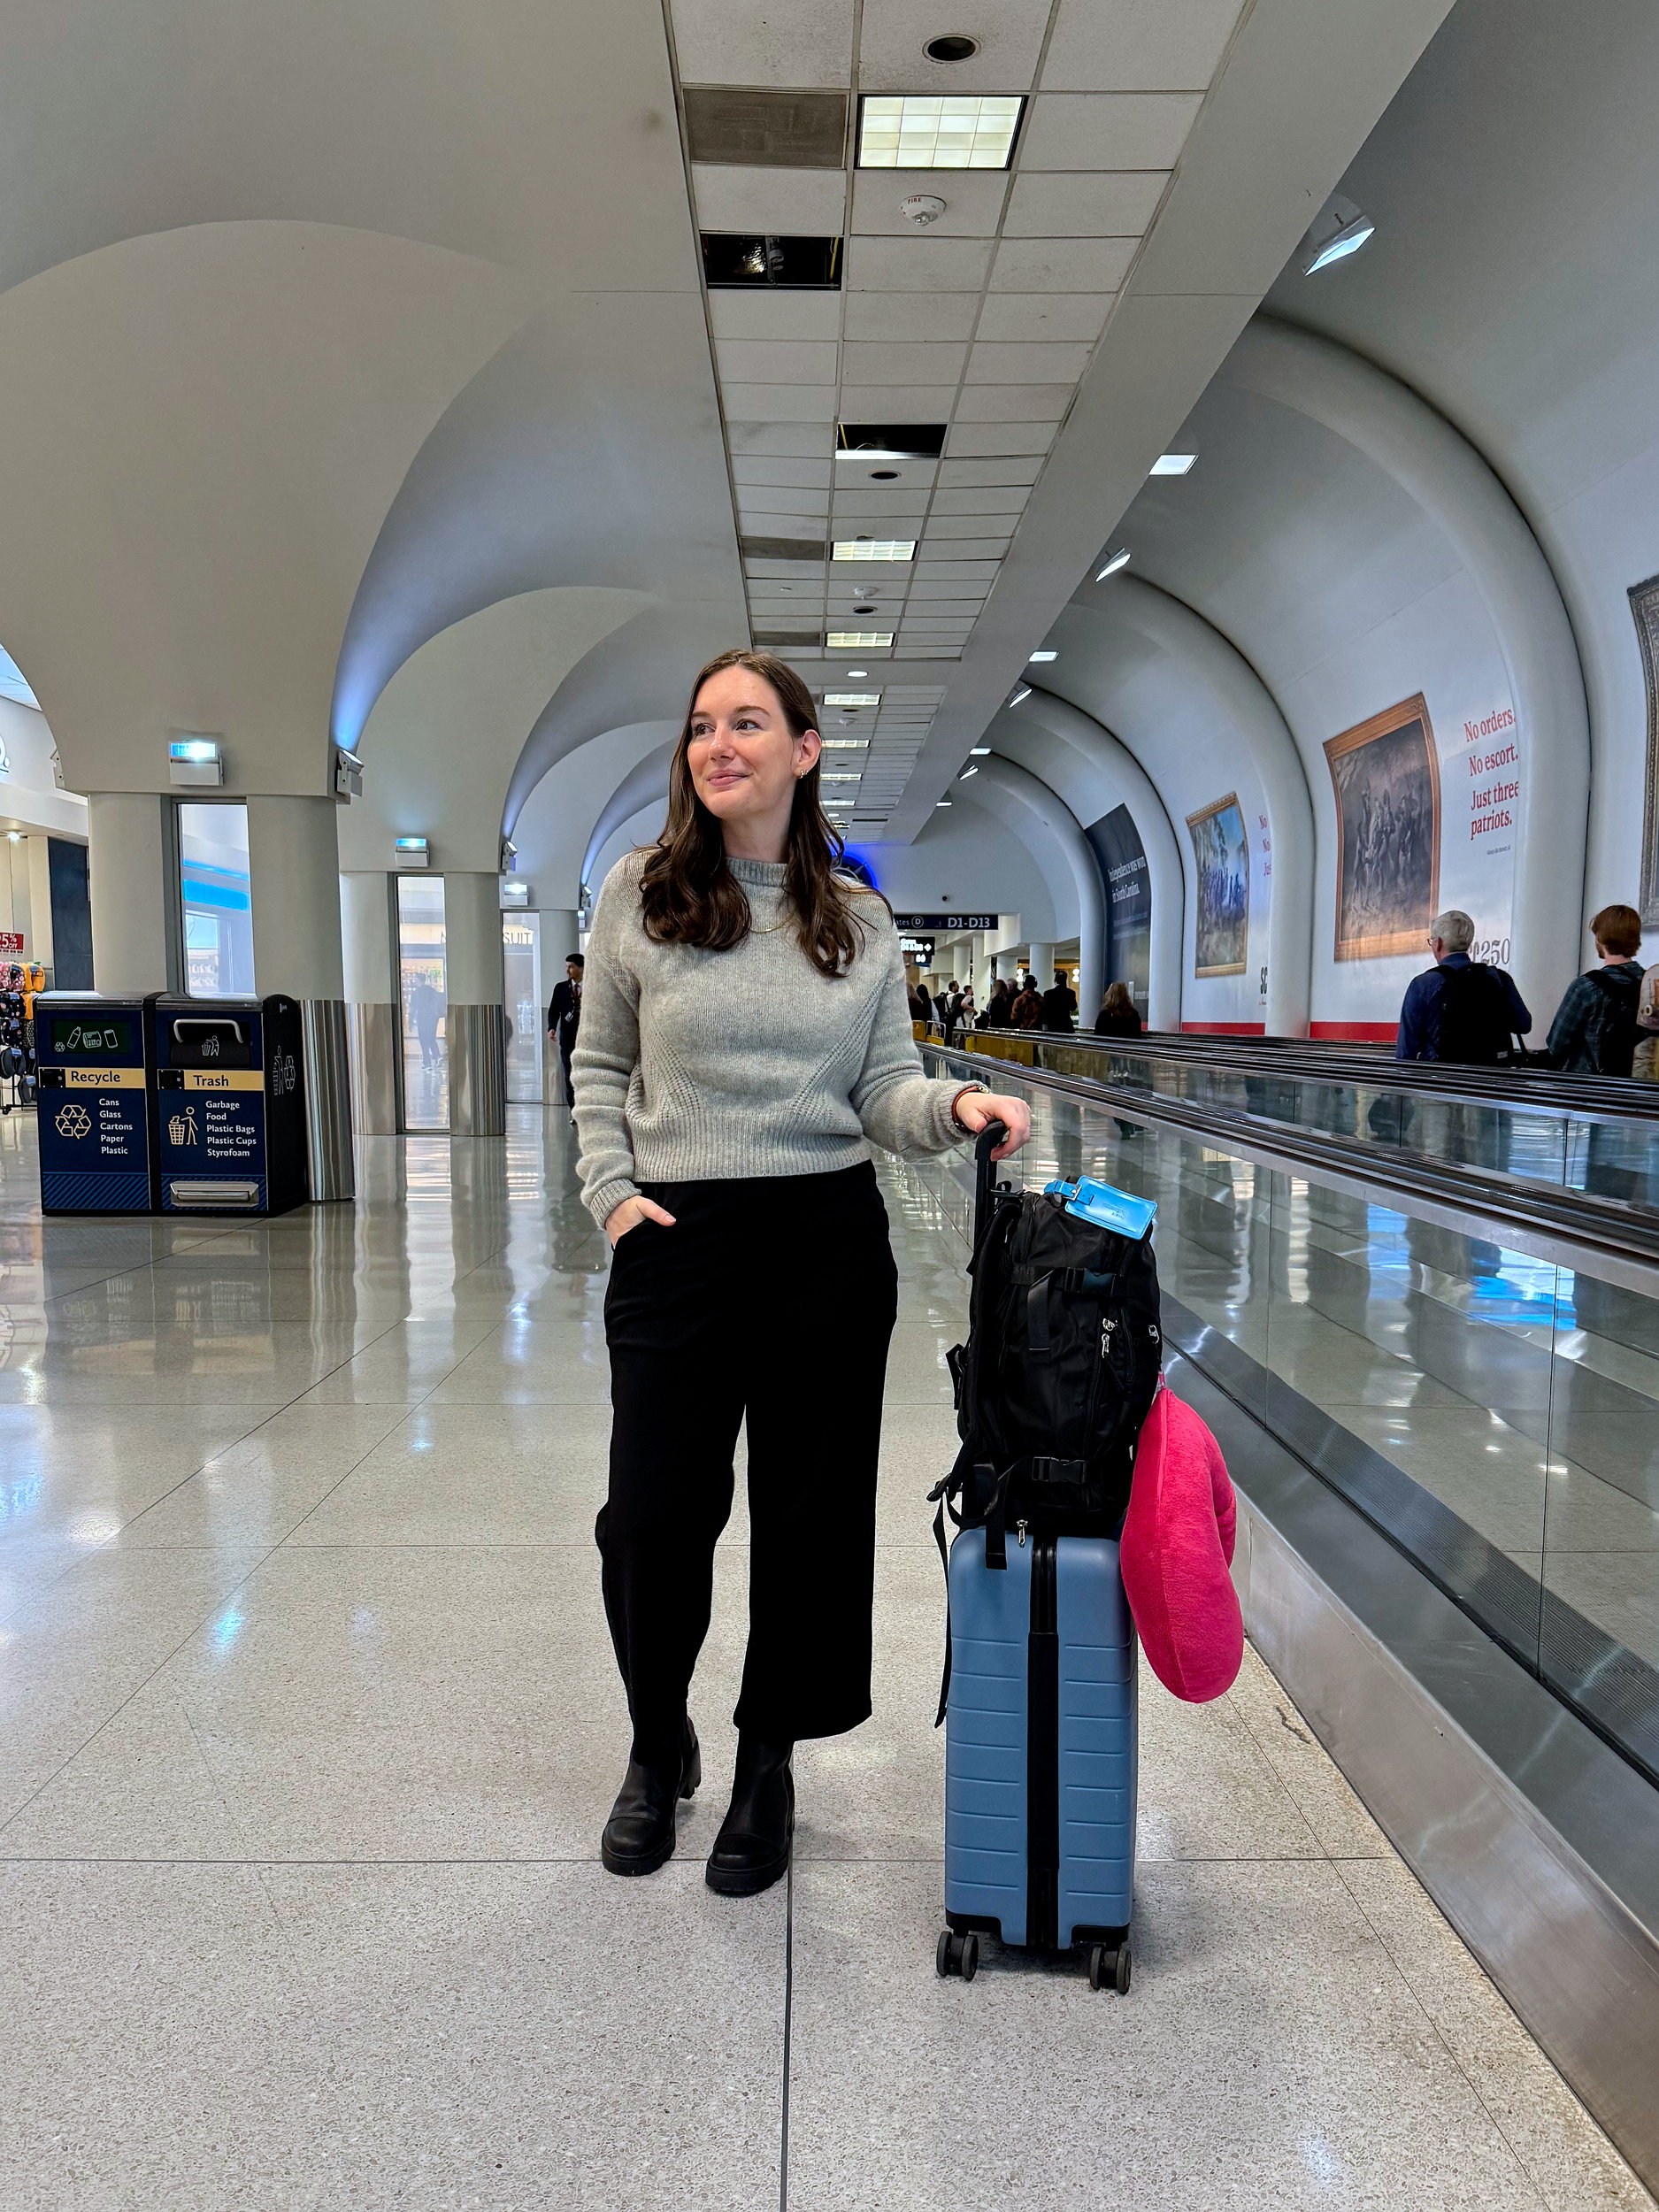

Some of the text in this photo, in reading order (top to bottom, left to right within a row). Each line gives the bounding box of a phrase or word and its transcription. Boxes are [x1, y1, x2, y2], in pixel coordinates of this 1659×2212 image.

[1463, 709, 1517, 742] No orders.
[1468, 743, 1518, 777] No escort.
[1471, 780, 1519, 811] Just three
[1471, 809, 1513, 841] patriots.
[948, 917, 991, 928] D1-D13
[0, 933, 18, 949] 5%
[70, 1071, 121, 1086] Recycle
[193, 1074, 229, 1087] Trash
[205, 1100, 241, 1110] Garbage
[99, 1110, 122, 1118] Glass
[206, 1112, 227, 1121] Food
[100, 1122, 134, 1131] Cartons
[206, 1124, 256, 1135] Plastic Bags
[100, 1134, 125, 1144] Paper
[206, 1136, 257, 1147] Plastic Cups
[101, 1146, 128, 1155] Plastic
[207, 1148, 250, 1158] Styrofoam
